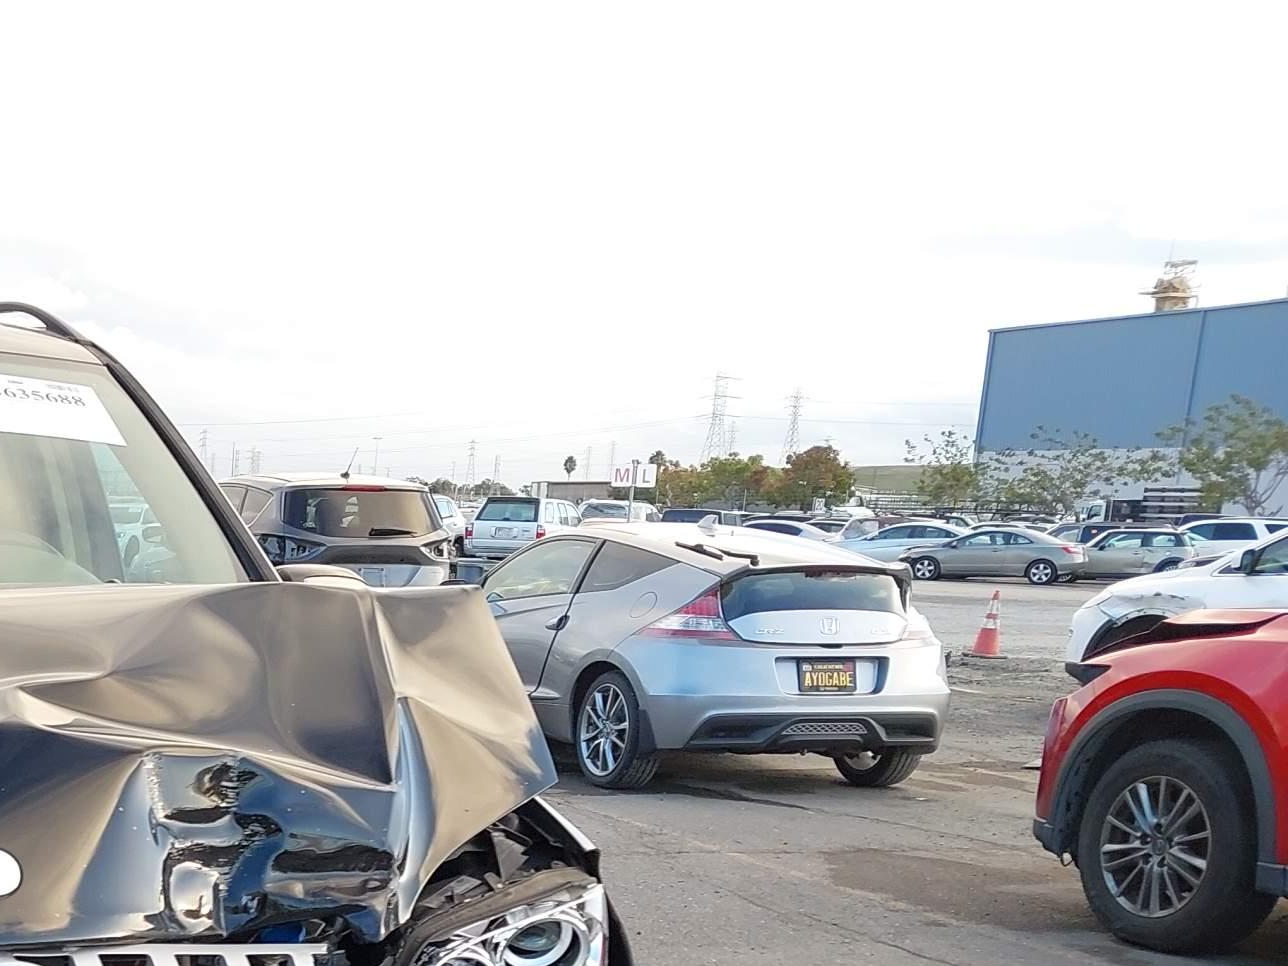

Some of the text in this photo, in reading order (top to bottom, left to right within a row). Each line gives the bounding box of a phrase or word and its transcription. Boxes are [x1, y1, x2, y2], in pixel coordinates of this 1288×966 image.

[614, 468, 630, 483] M
[642, 468, 651, 483] L
[804, 671, 855, 687] AYOGABE
